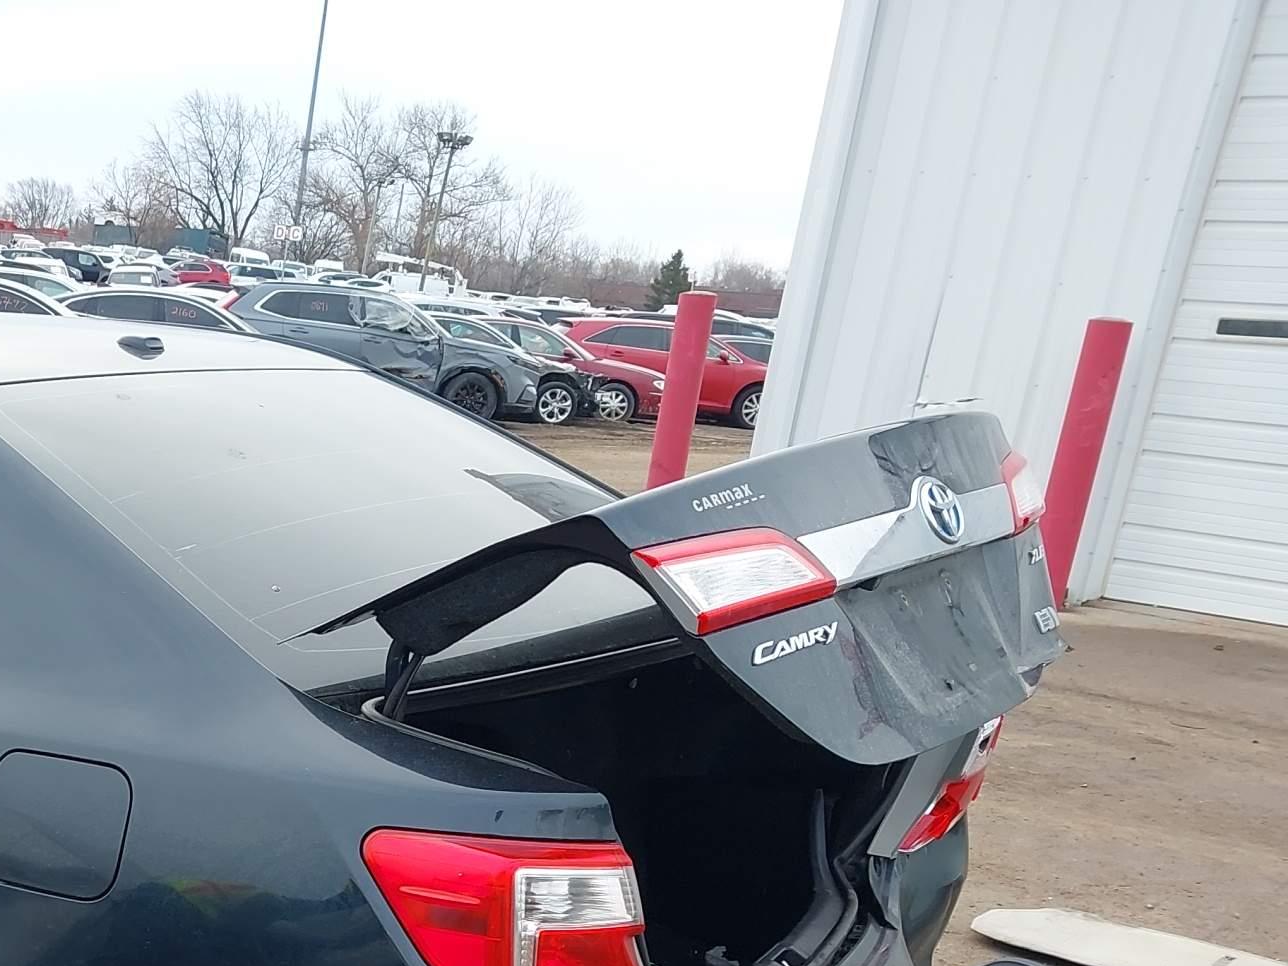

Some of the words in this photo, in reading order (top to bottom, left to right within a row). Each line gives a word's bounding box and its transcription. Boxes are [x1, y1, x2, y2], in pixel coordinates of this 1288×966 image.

[276, 226, 284, 238] D
[292, 228, 300, 239] C
[171, 306, 197, 319] 2160
[752, 621, 839, 666] CAMRY
